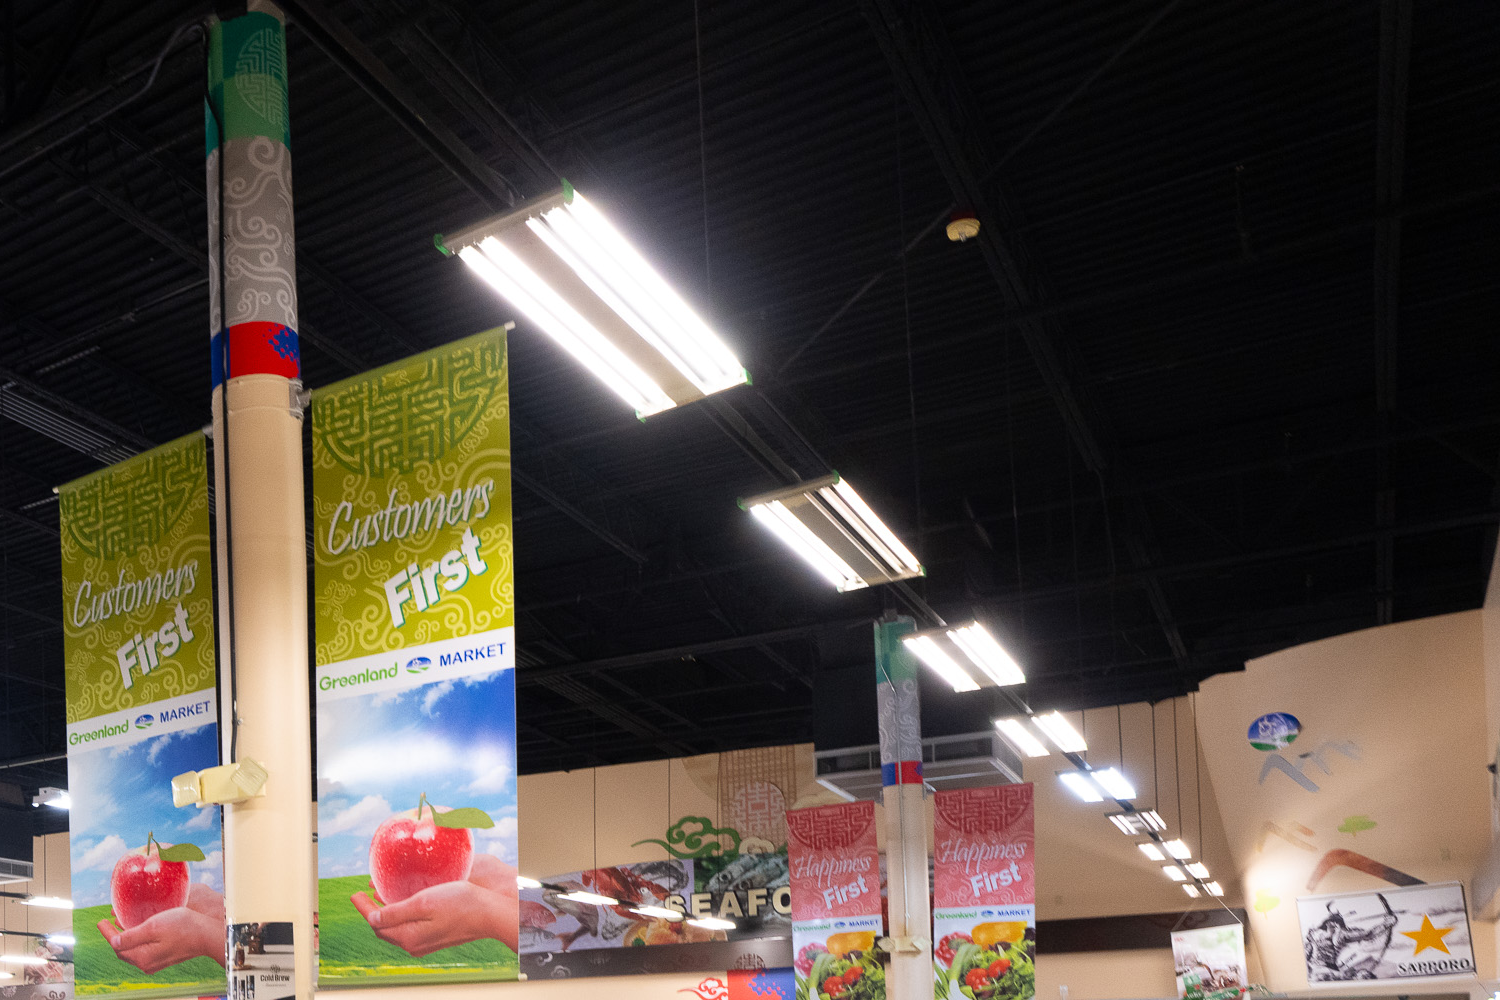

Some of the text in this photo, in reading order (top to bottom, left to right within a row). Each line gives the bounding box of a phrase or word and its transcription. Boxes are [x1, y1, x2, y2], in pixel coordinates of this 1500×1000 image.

[328, 479, 494, 555] Customers
[73, 559, 199, 628] Customers
[384, 525, 489, 628] First
[116, 602, 196, 690] First
[319, 642, 507, 691] Greenland MARKET
[69, 700, 211, 746] Greenland MARKET
[794, 854, 873, 888] Happiness
[941, 838, 1028, 875] Happiness
[822, 874, 869, 910] First
[971, 861, 1022, 898] First
[793, 919, 879, 933] Greenland MARKET
[934, 909, 1031, 921] Greenland MARKET
[260, 974, 290, 982] Cold Brew
[1396, 958, 1472, 977] SAPPORO
